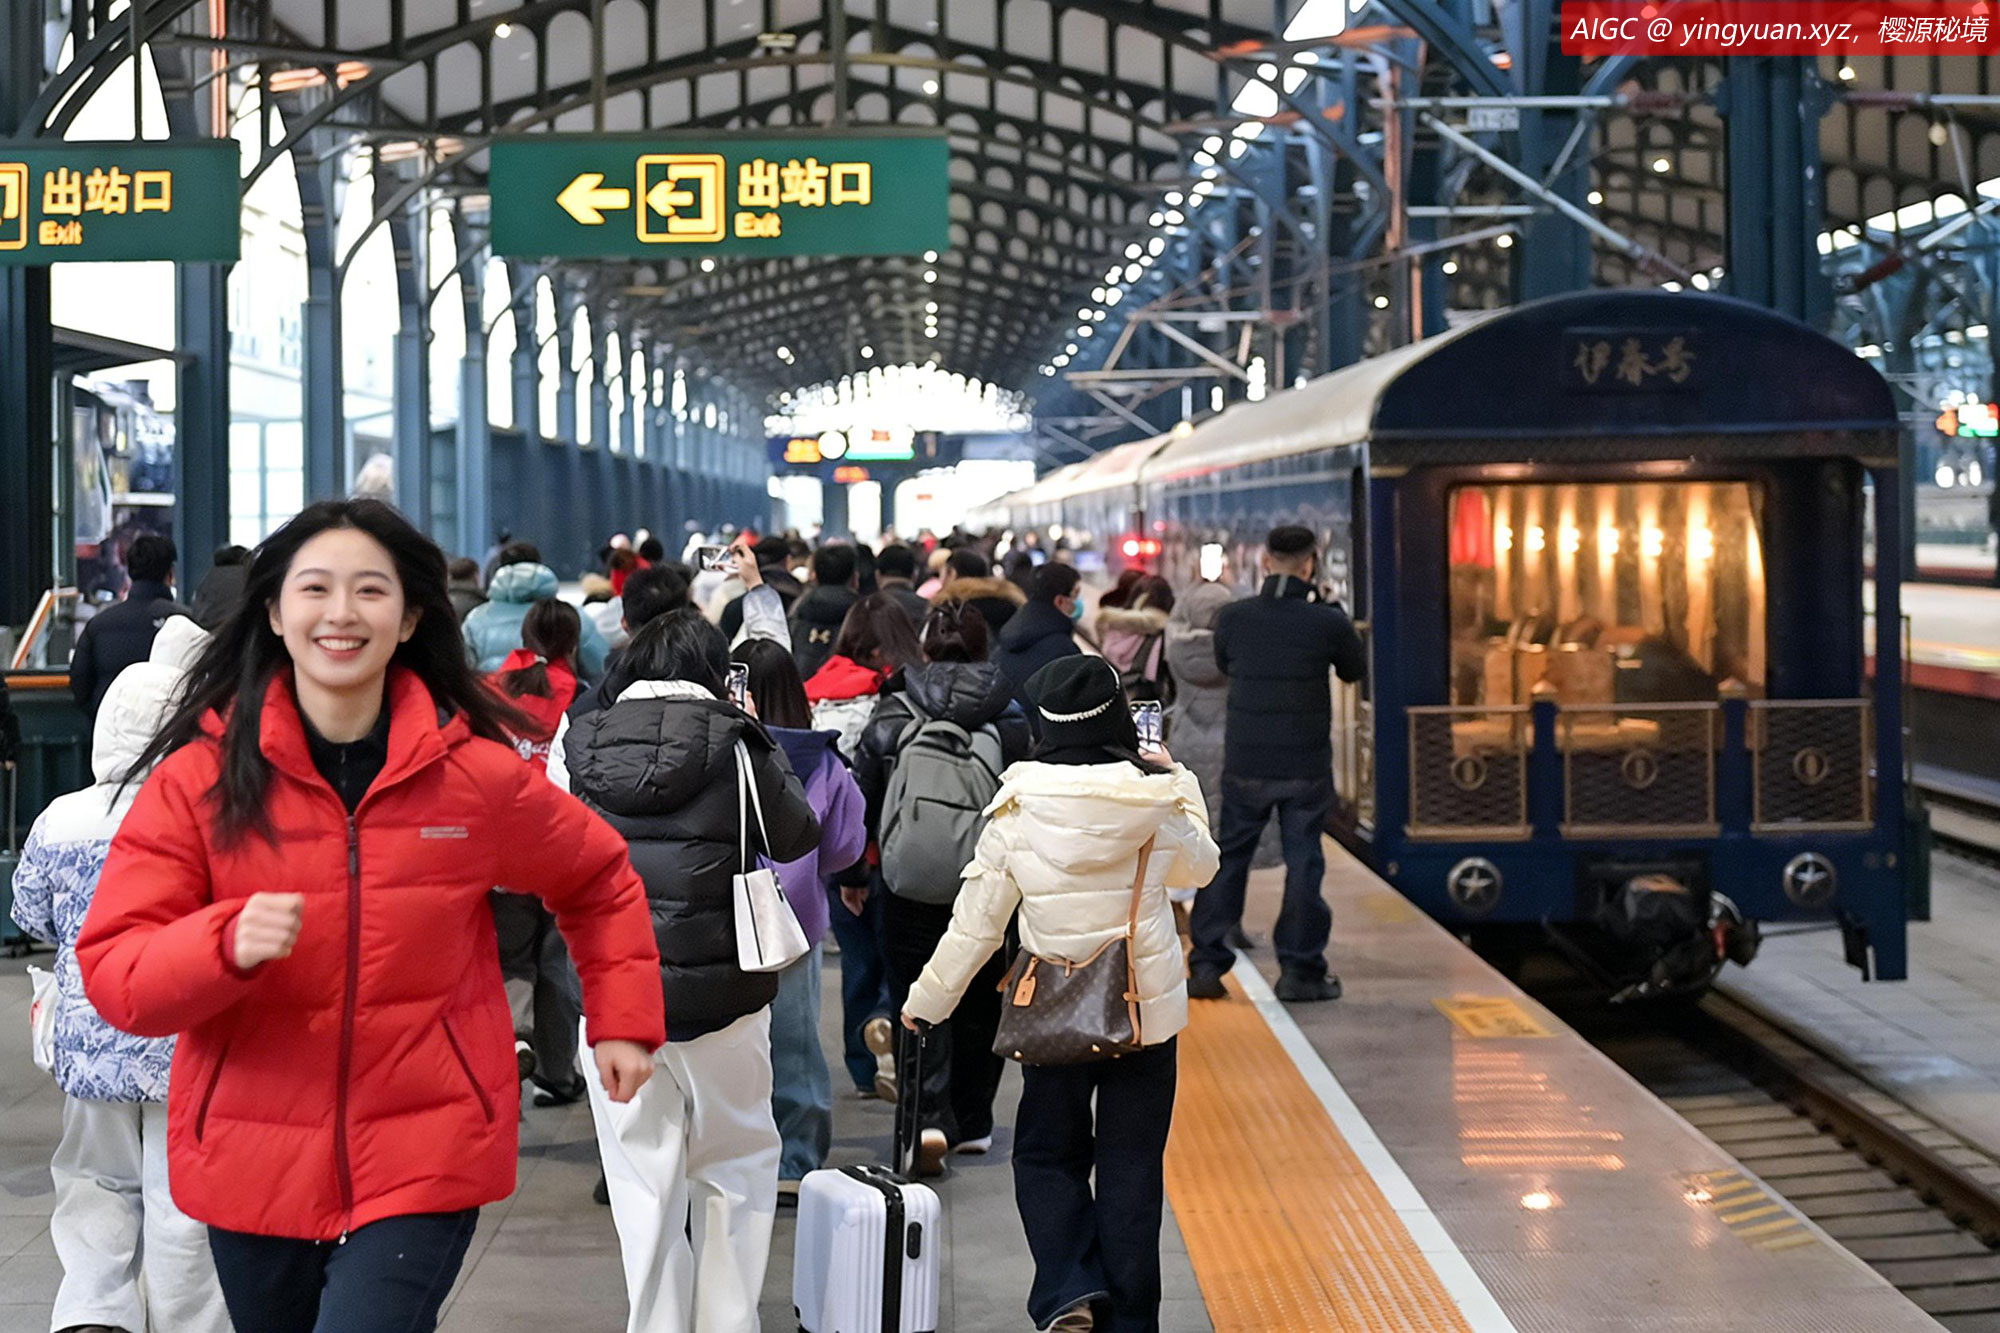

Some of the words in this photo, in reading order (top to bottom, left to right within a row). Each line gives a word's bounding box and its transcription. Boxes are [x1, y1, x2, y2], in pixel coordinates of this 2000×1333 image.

[42, 165, 172, 216] 出站口
[737, 157, 871, 208] 出站口
[38, 219, 83, 246] Exit
[734, 211, 782, 238] Exit
